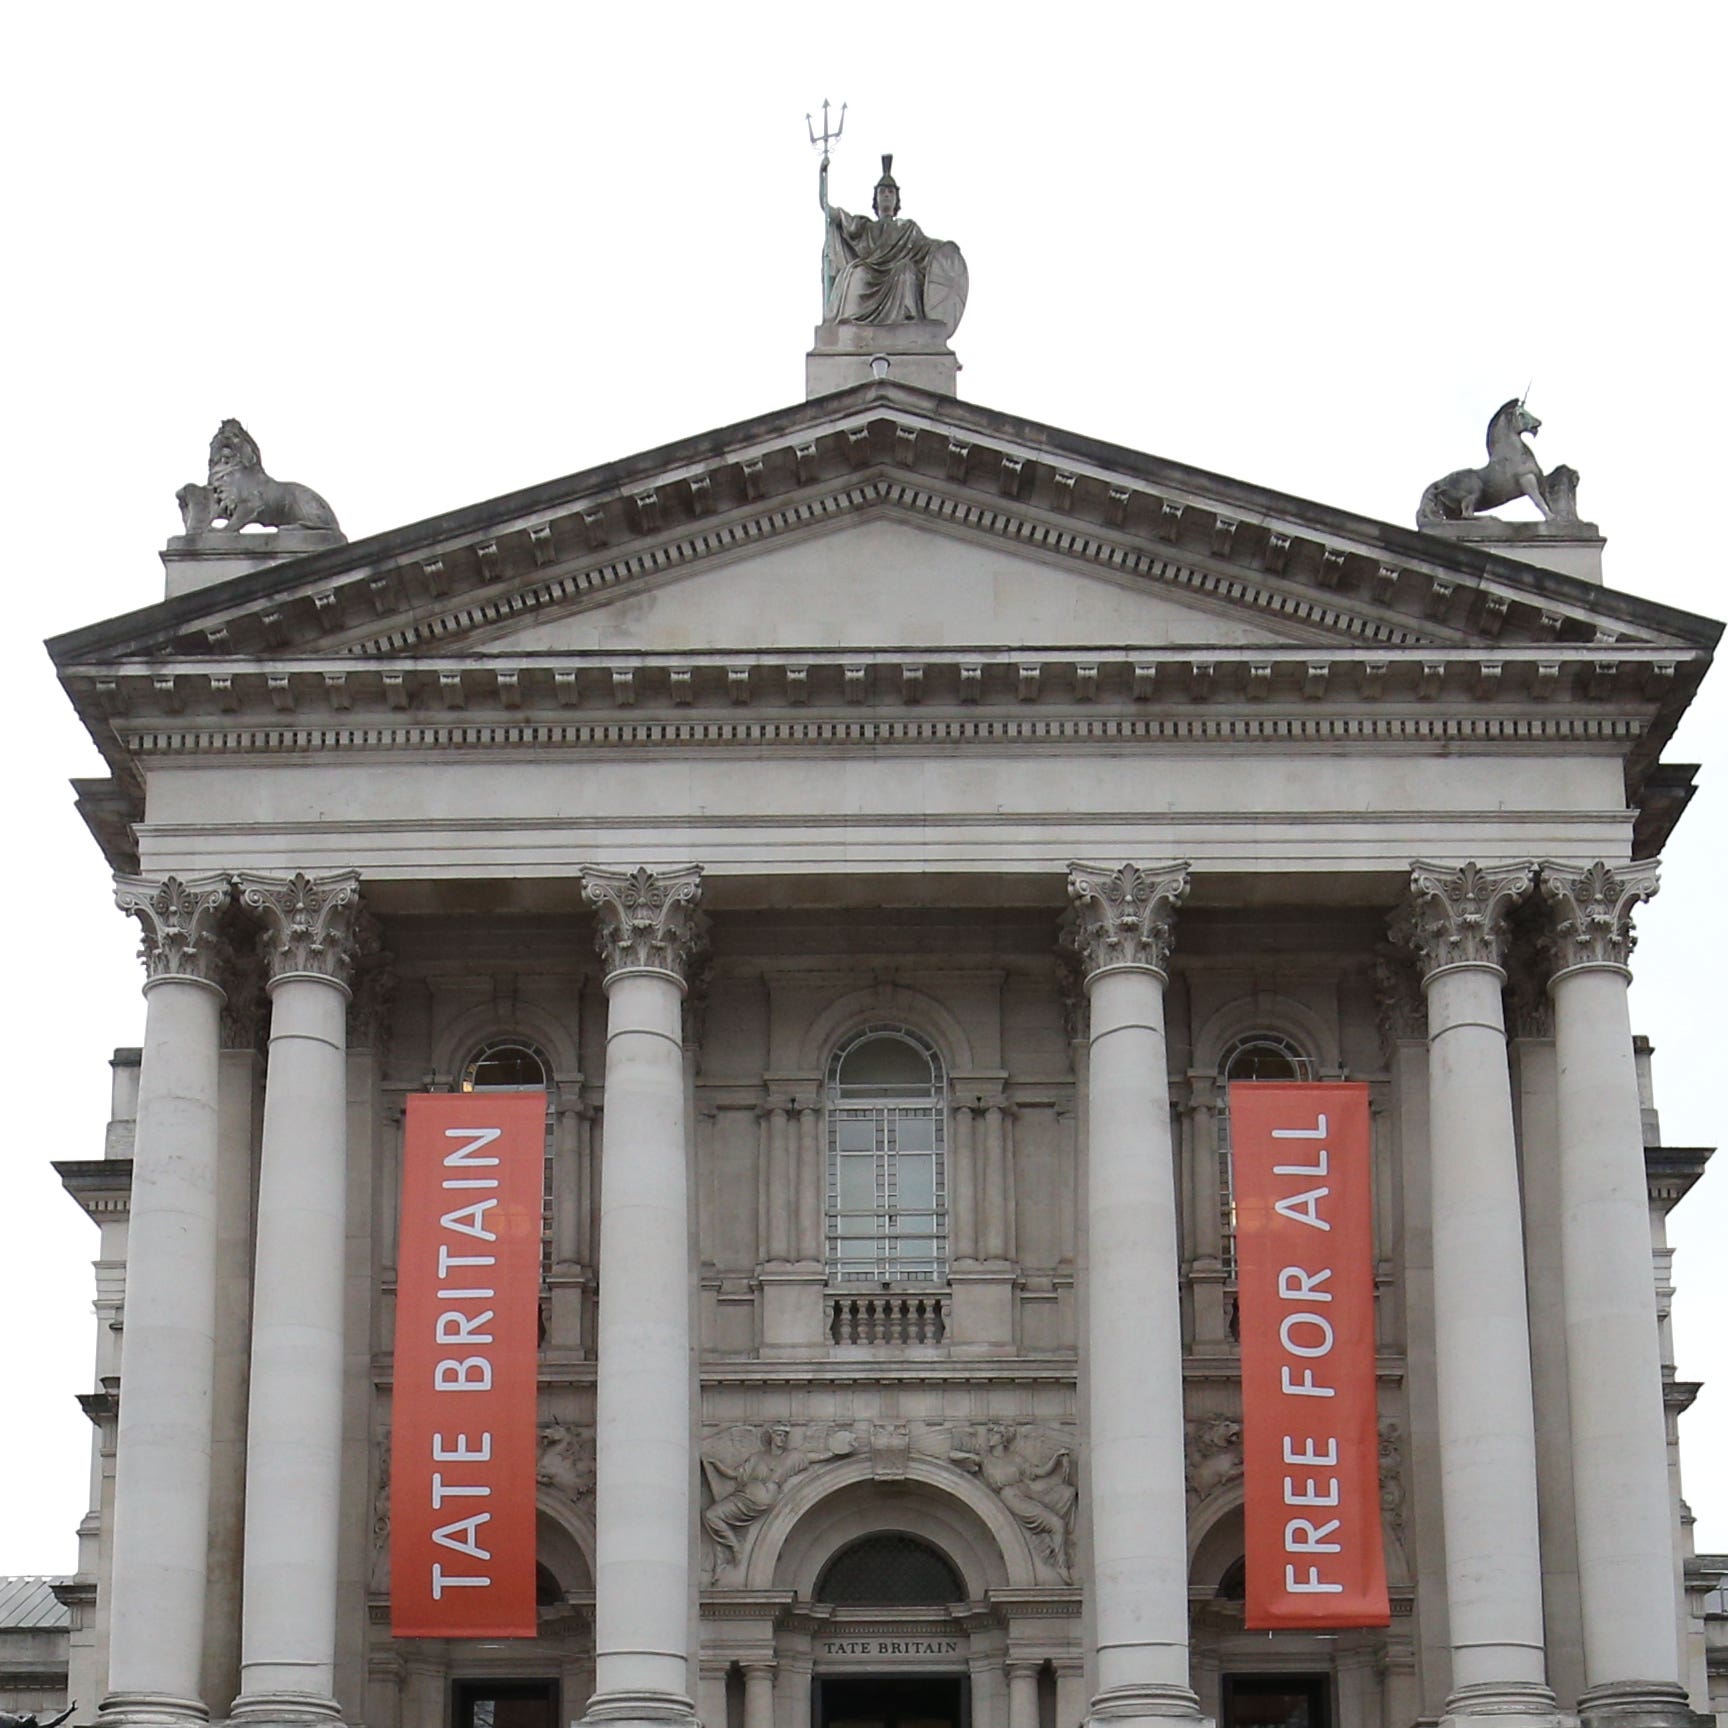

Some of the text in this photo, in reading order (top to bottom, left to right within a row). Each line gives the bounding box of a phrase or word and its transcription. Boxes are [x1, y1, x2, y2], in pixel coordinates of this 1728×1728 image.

[432, 1128, 502, 1599] TATE BRITAIN
[1271, 1113, 1344, 1594] FREE FOR ALL
[824, 1642, 957, 1654] TATE BRITAIN
